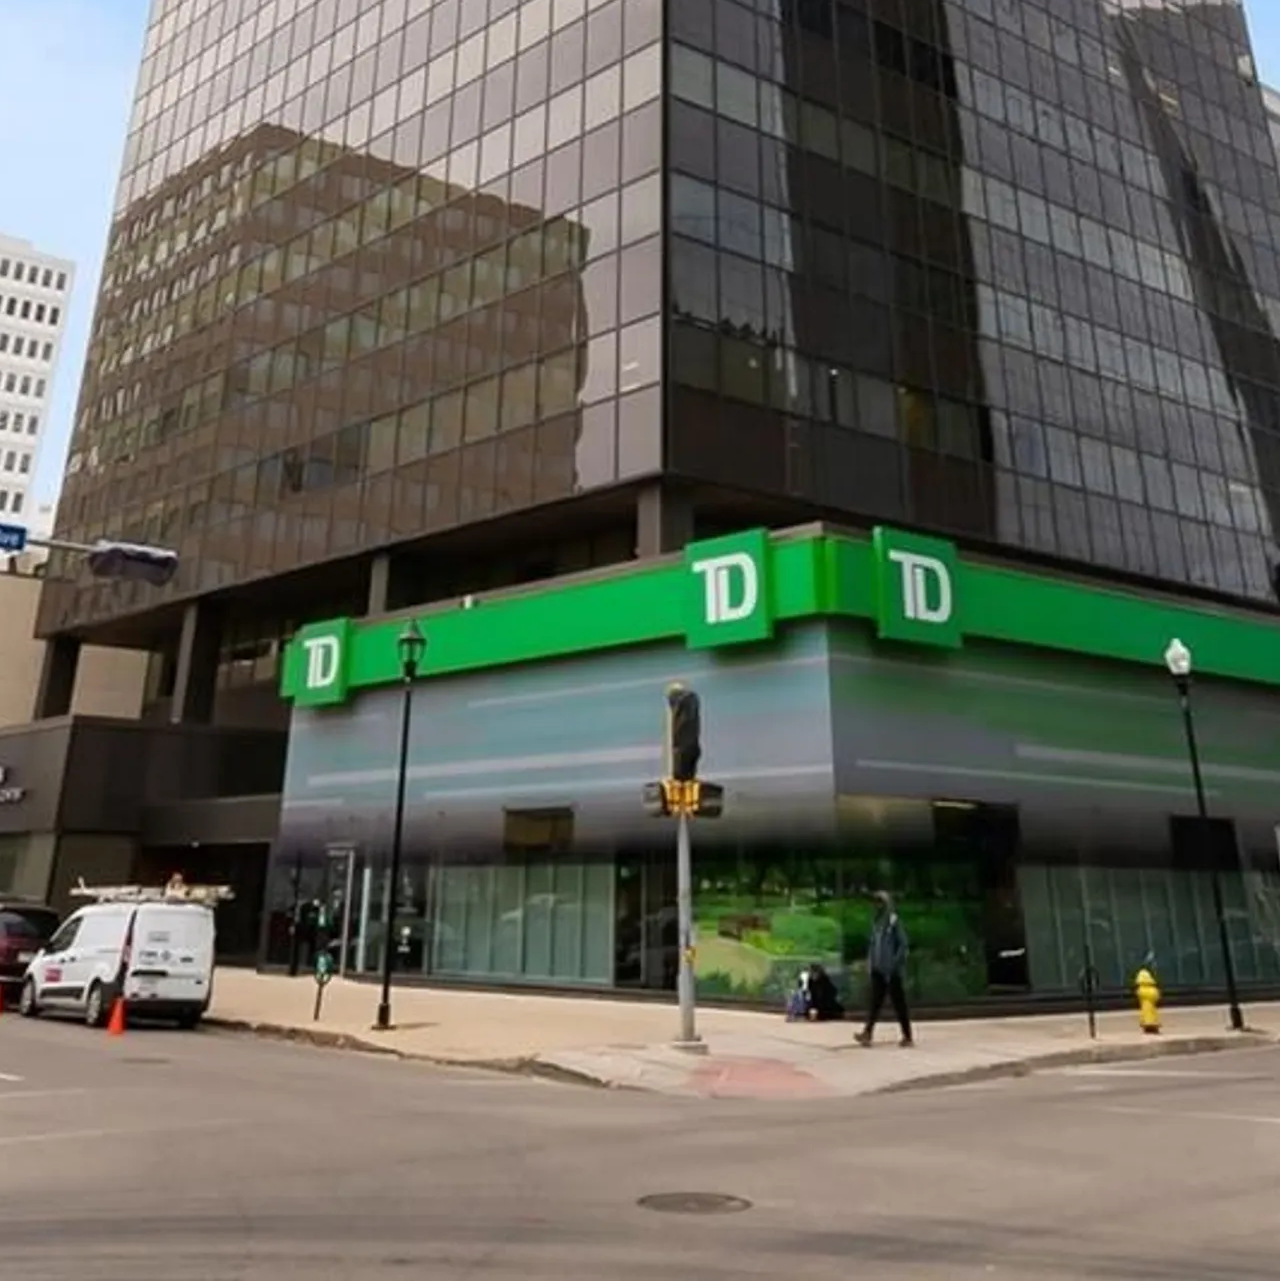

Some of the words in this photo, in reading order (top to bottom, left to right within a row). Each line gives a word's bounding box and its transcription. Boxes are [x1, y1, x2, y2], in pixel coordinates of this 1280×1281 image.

[691, 551, 758, 625] TD
[888, 548, 952, 623] TD
[303, 635, 340, 689] TD
